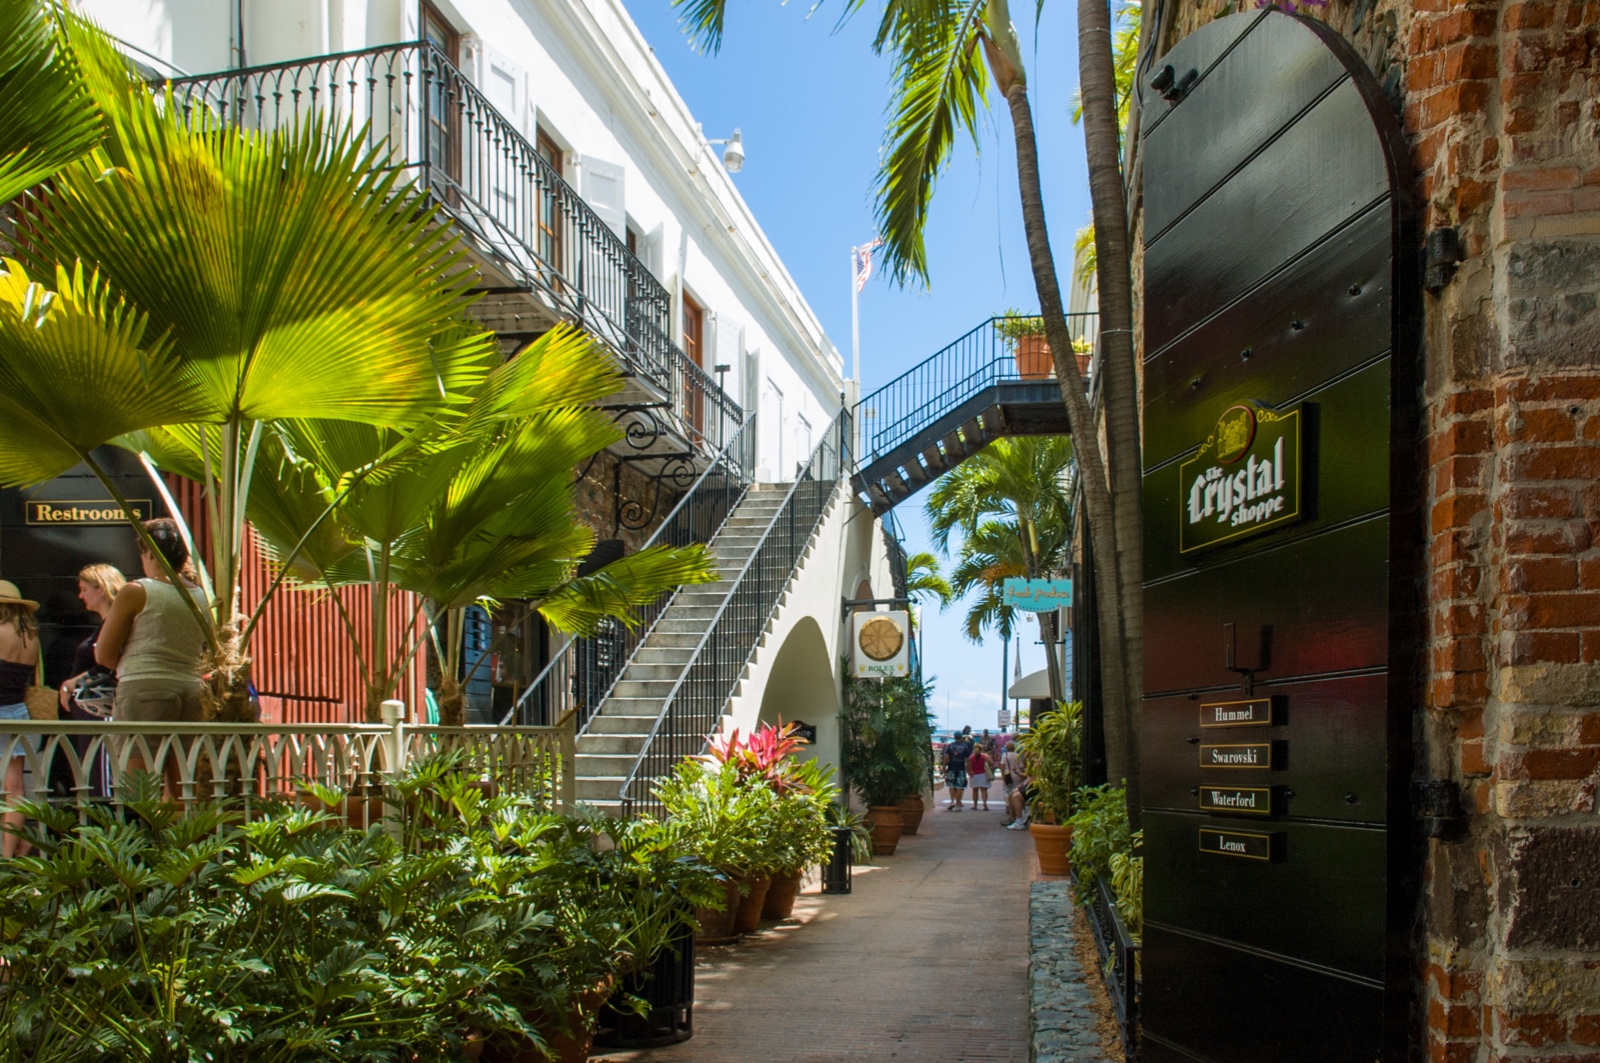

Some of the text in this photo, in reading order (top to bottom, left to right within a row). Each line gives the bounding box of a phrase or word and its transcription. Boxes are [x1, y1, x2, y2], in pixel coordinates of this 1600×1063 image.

[1188, 436, 1285, 524] Crystal
[1206, 466, 1224, 482] The
[1231, 496, 1284, 527] shoppe
[1215, 705, 1253, 722] Hummel
[1212, 748, 1257, 763] Swarovski
[1211, 791, 1255, 808] Waterford
[1219, 835, 1246, 853] Lenox
